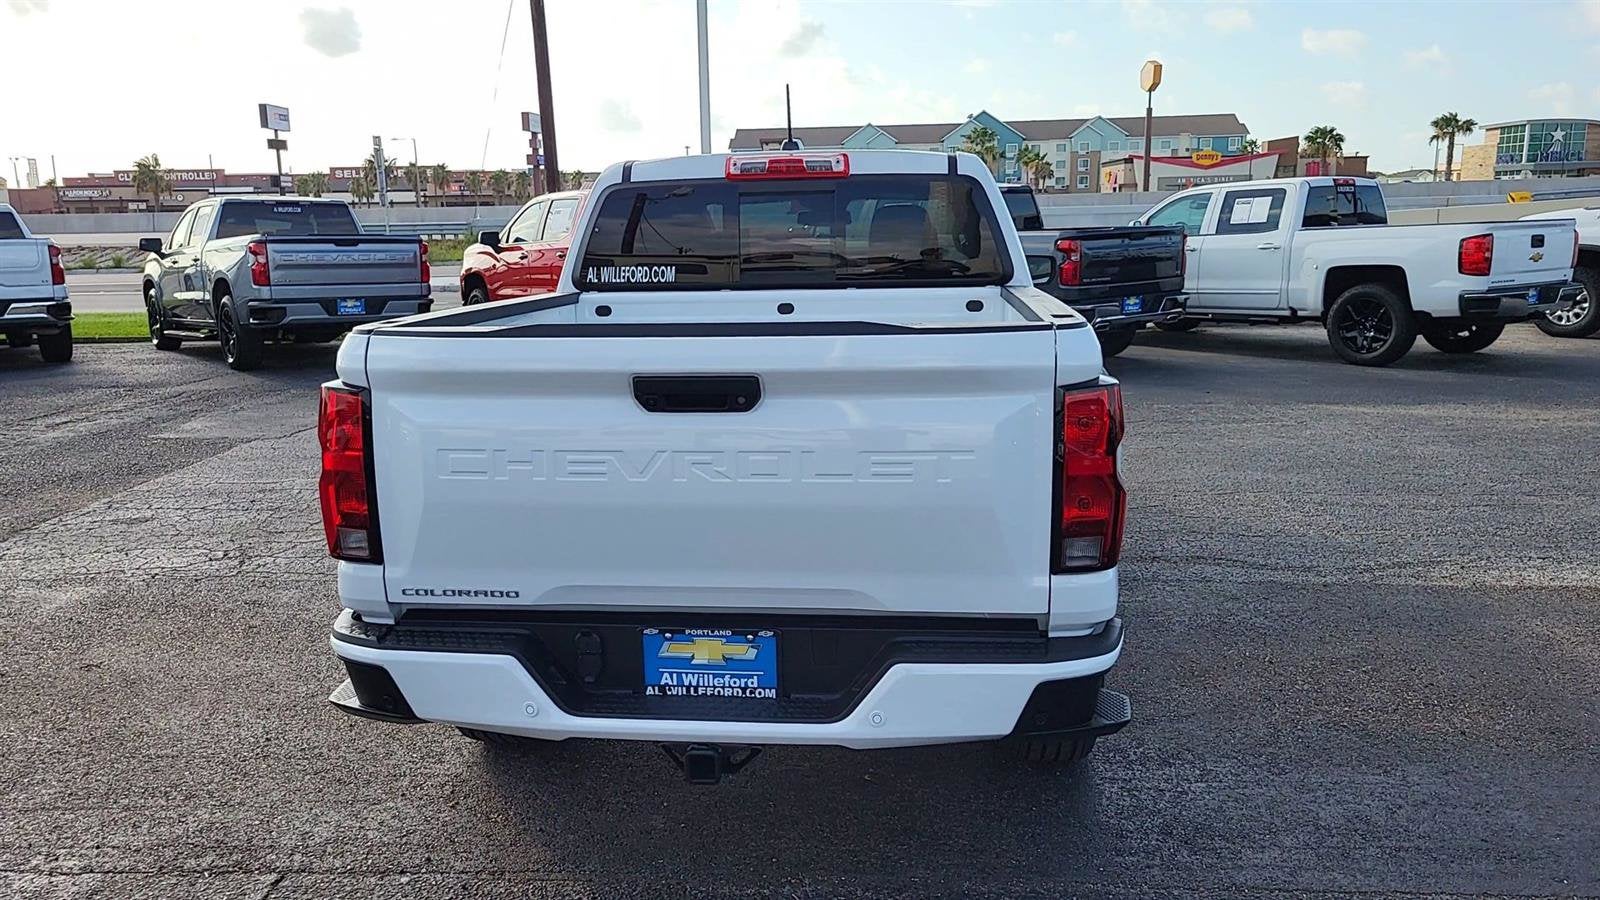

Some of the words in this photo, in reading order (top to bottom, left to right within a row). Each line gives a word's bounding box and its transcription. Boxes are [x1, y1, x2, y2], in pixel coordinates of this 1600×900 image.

[1195, 153, 1218, 161] Denny's
[161, 171, 216, 181] ONTROLLED
[587, 266, 598, 282] AL
[600, 266, 675, 282] WILLEFORD.COM
[436, 448, 977, 483] CHEVROLET
[401, 588, 520, 599] COLORADO
[660, 672, 677, 686] Al
[681, 673, 758, 688] Willeford
[645, 686, 663, 696] AL
[664, 686, 777, 698] WILLEFORD.COM
